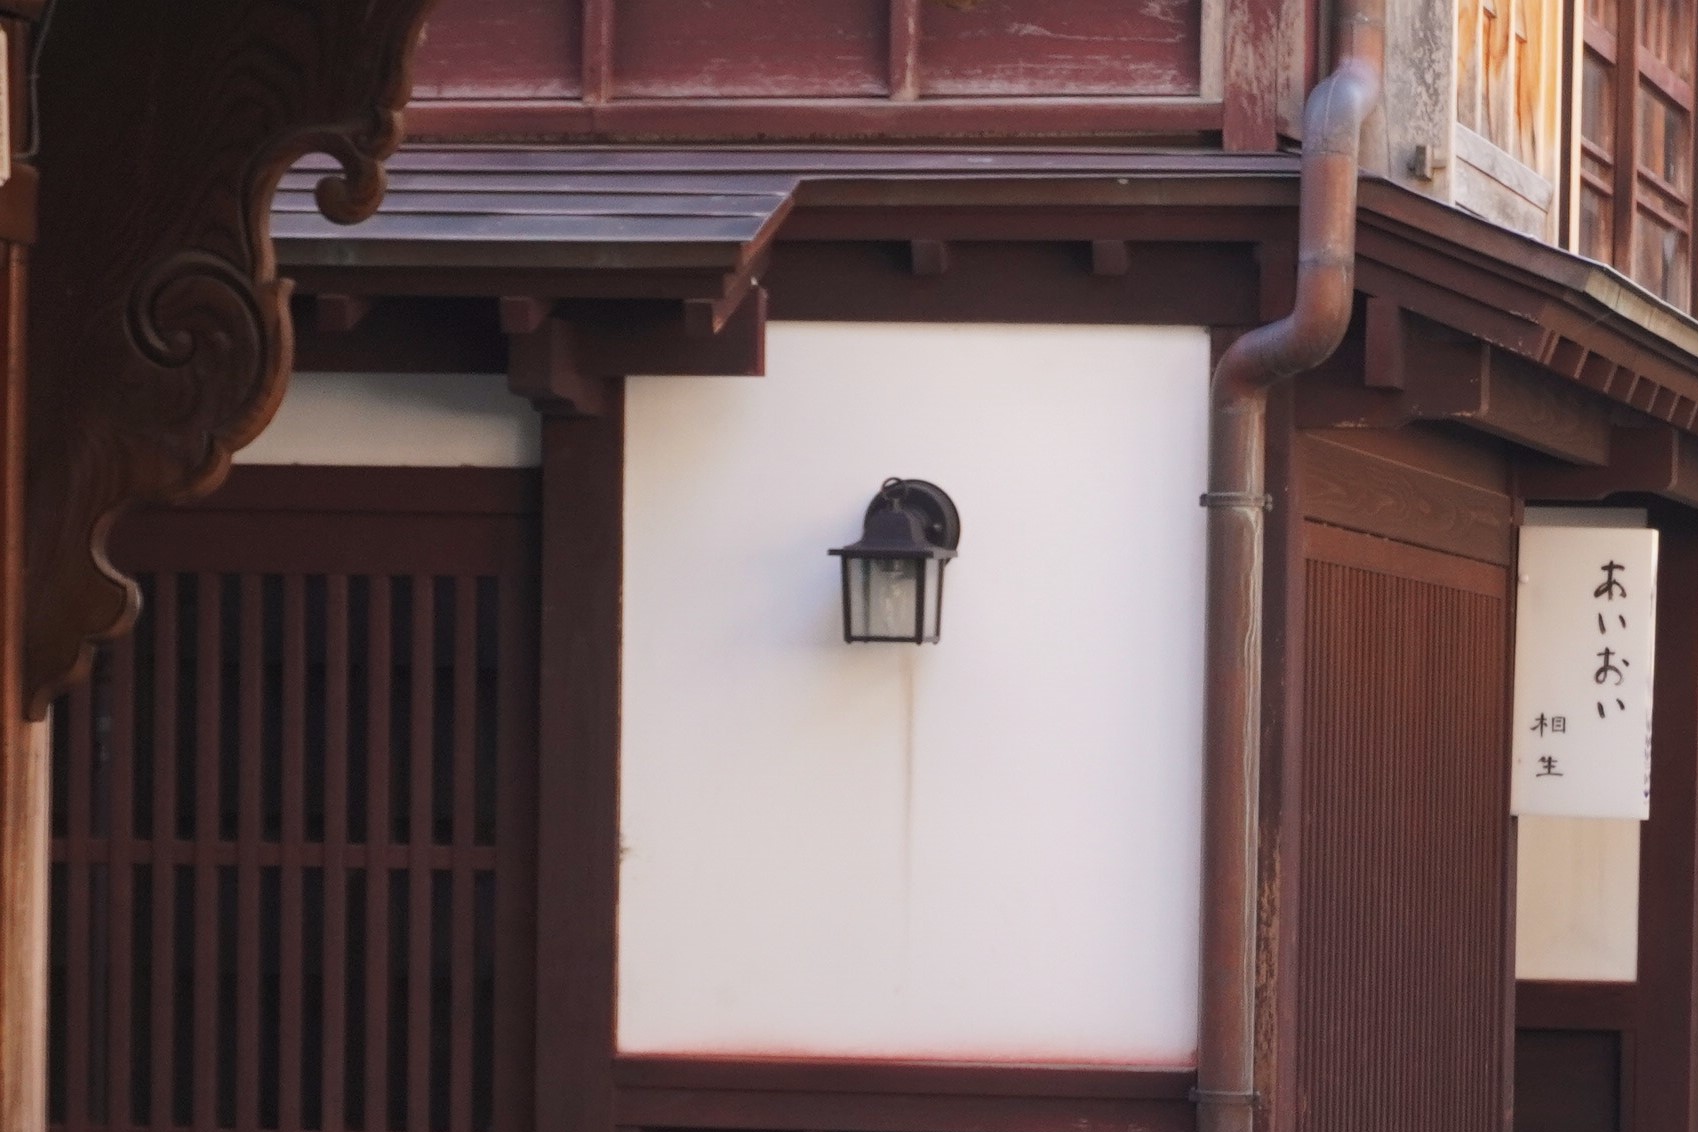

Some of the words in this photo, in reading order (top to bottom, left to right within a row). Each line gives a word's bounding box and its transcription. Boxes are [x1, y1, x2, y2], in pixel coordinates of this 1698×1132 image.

[1592, 559, 1630, 720] あいおい
[1529, 711, 1567, 778] 相生
